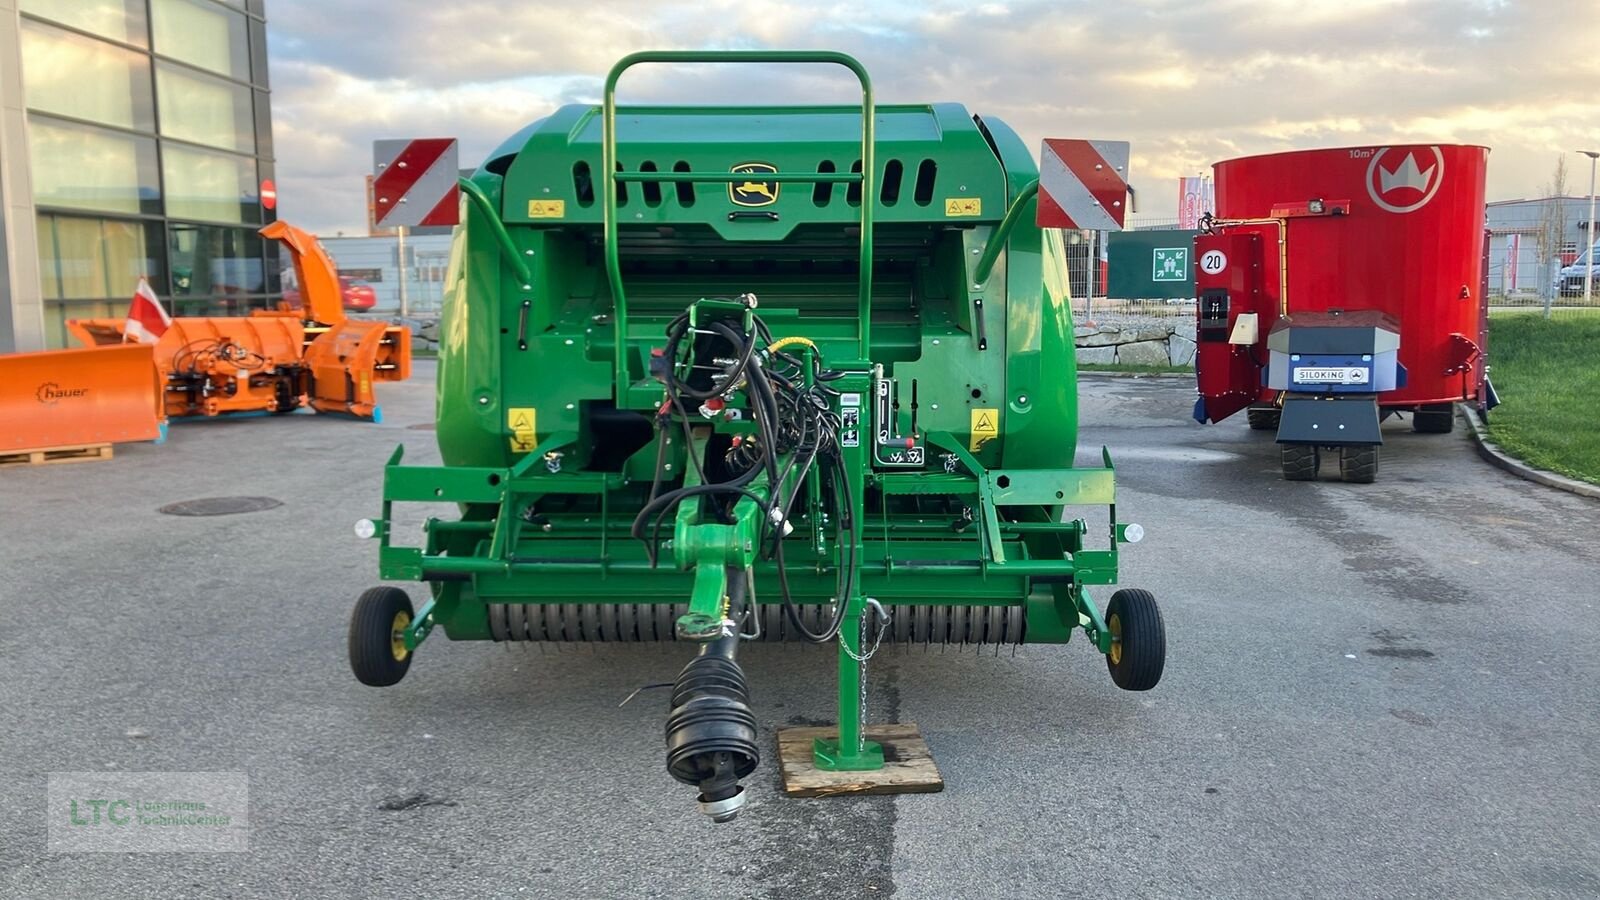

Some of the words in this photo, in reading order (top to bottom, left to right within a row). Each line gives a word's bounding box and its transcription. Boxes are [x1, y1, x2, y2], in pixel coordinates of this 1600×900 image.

[1206, 255, 1221, 270] 20
[1299, 371, 1344, 379] SILOKING
[44, 387, 89, 399] hauer
